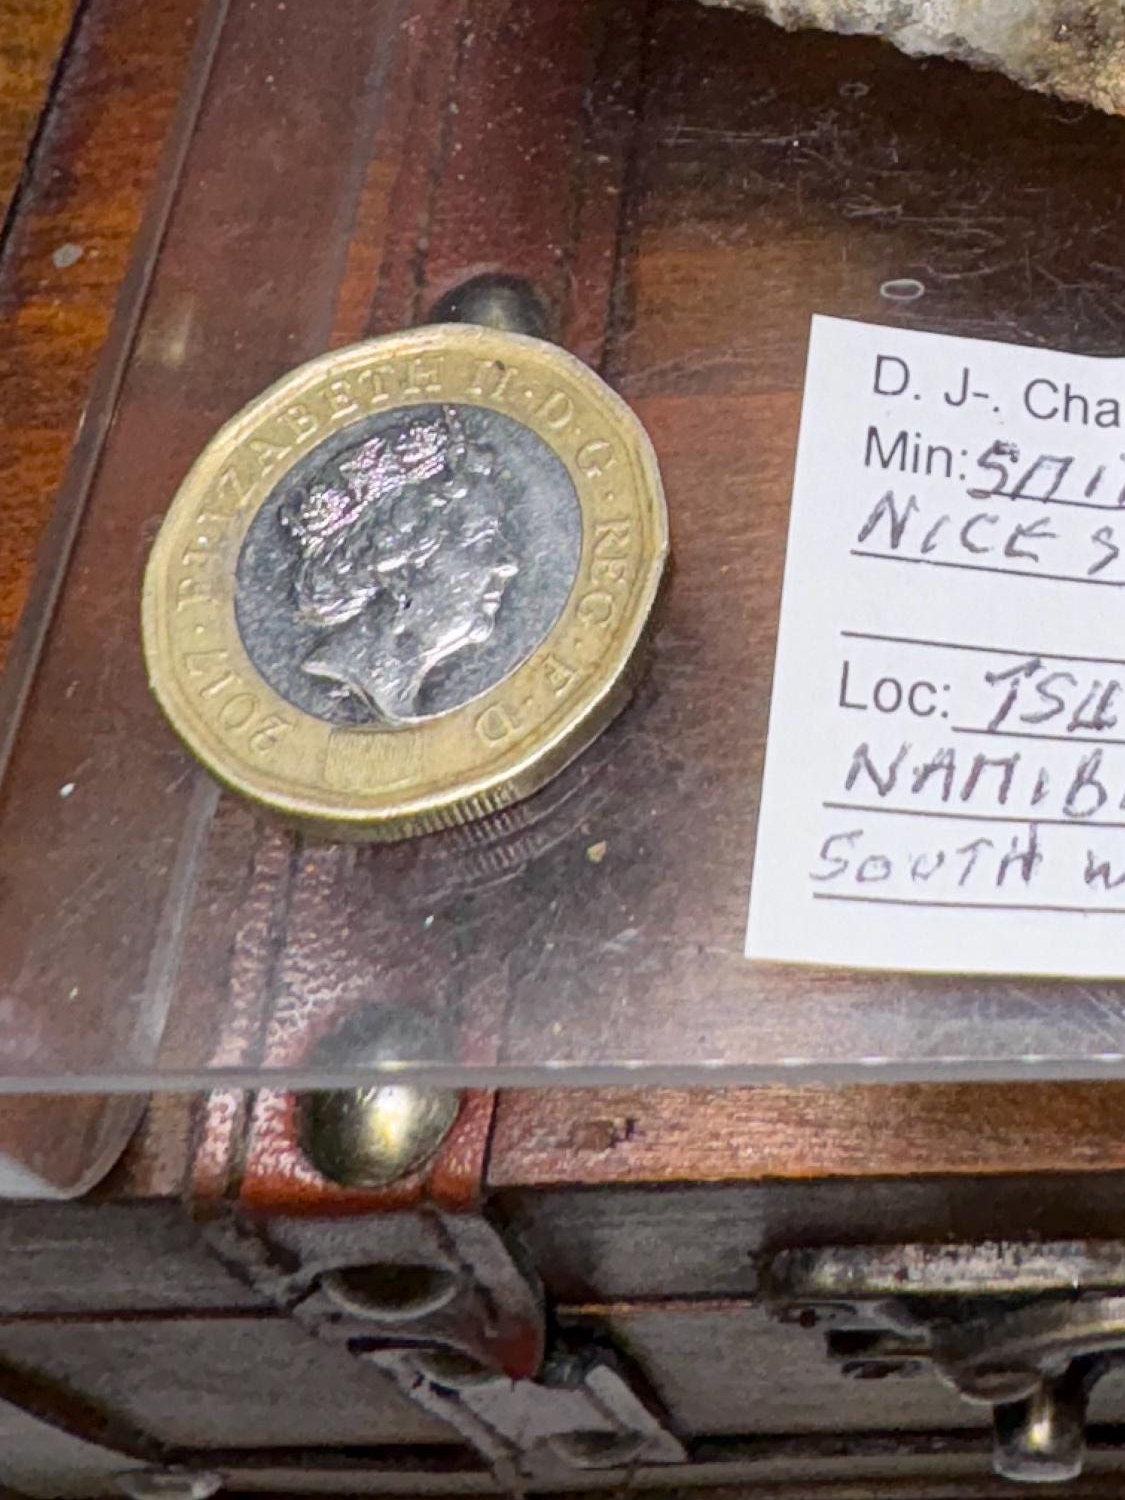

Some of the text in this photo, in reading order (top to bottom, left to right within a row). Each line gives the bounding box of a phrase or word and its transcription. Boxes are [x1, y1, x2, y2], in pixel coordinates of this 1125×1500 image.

[873, 353, 921, 401] D.
[864, 425, 969, 482] Min:
[857, 490, 1058, 563] NICE
[838, 659, 952, 719] Loc:
[809, 822, 1043, 887] SOUTH
